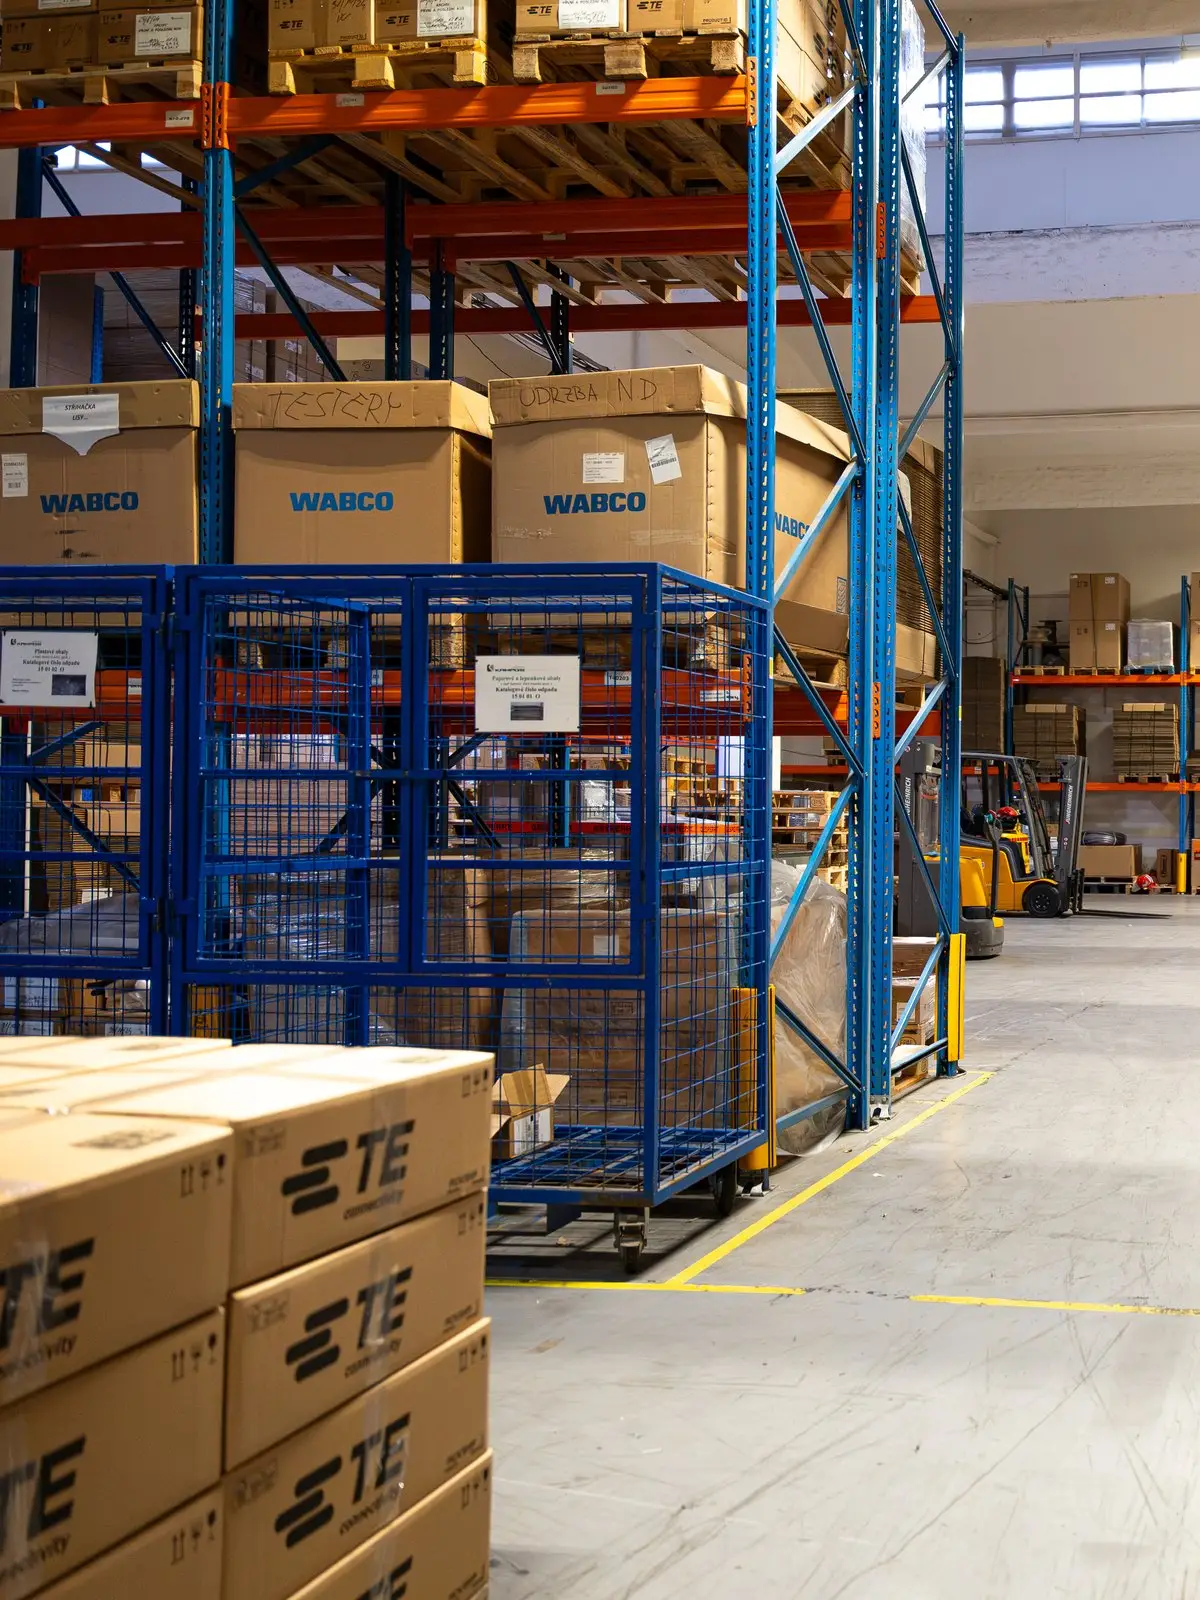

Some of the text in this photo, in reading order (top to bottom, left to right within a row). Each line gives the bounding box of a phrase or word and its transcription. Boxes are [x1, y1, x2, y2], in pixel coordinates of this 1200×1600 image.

[267, 387, 402, 428] TESTERY
[40, 492, 139, 513] WABCO
[290, 491, 394, 511] WABCO
[543, 492, 646, 514] WABCO
[356, 1119, 415, 1194] TE
[0, 1237, 95, 1350] TE
[355, 1266, 413, 1351] TE
[351, 1411, 411, 1505] TE
